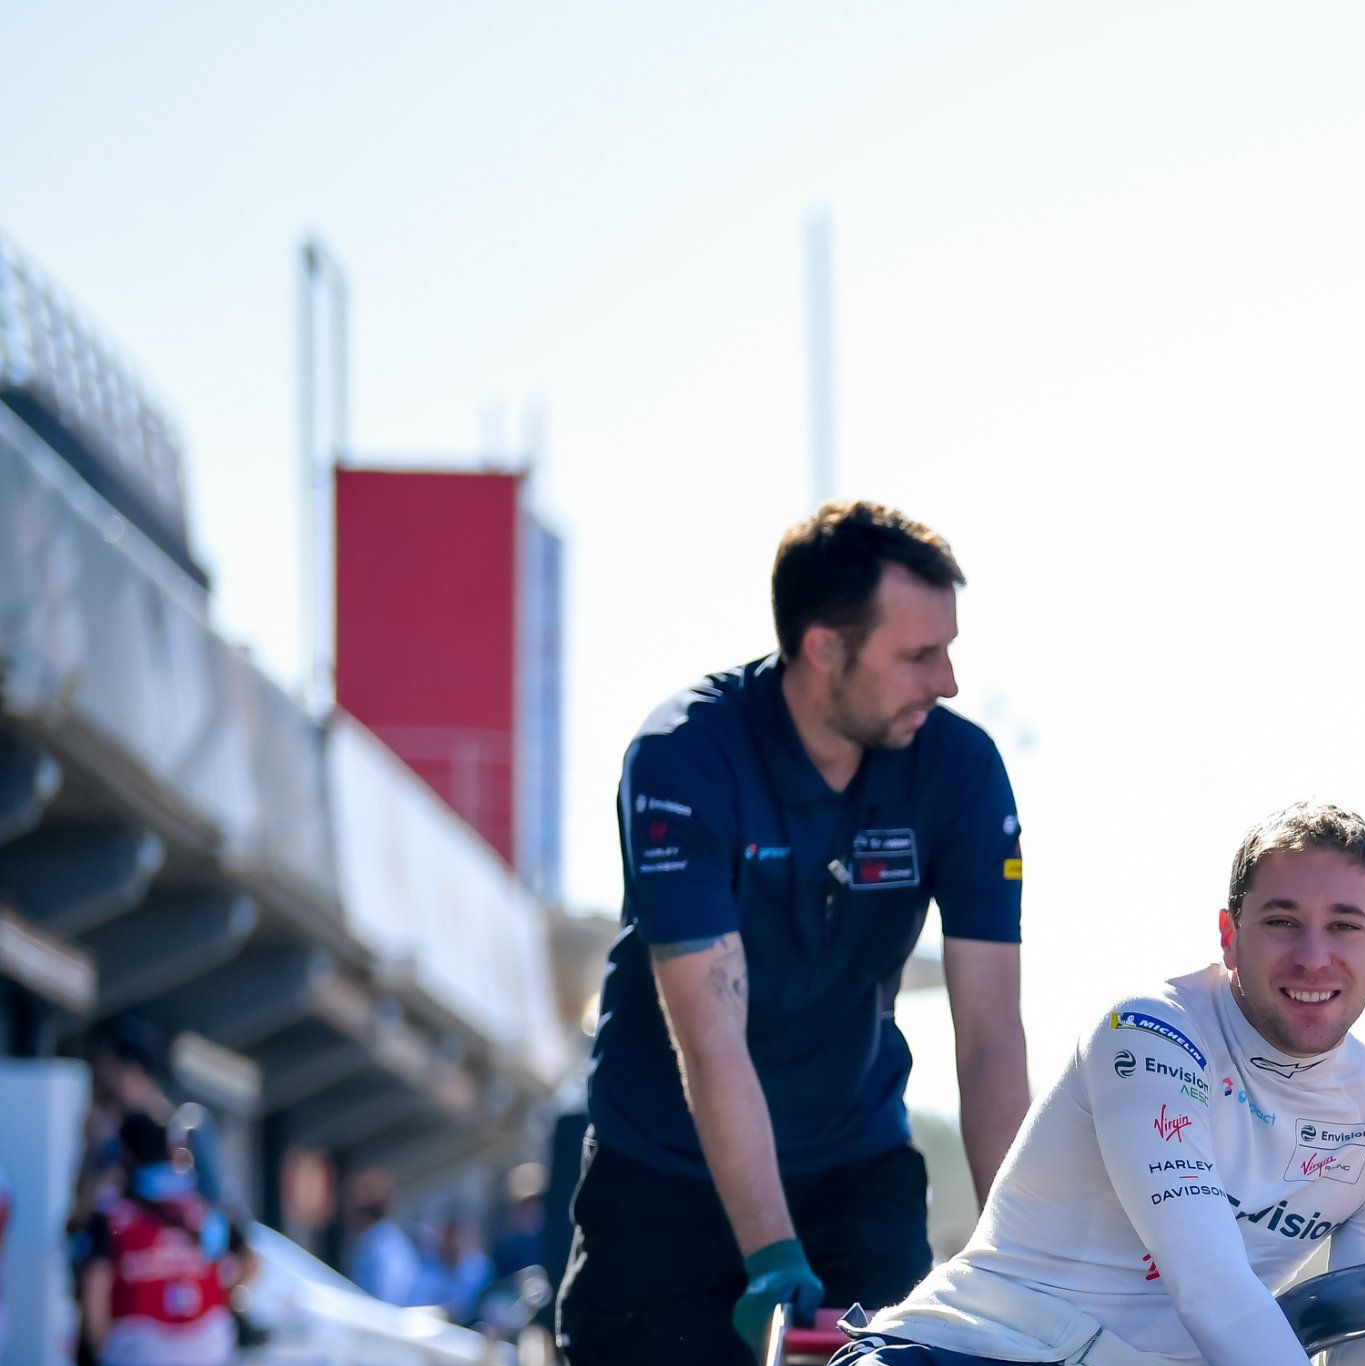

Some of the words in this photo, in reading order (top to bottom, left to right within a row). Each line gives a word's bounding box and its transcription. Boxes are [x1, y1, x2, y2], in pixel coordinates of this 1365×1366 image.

[1139, 1018, 1202, 1062] MICHELIN
[1144, 1057, 1209, 1094] Envision
[1153, 1103, 1193, 1143] Virgin
[1149, 1159, 1214, 1174] HARLEY
[1301, 1152, 1336, 1178] Virgin
[1150, 1184, 1228, 1206] DAVIDSON
